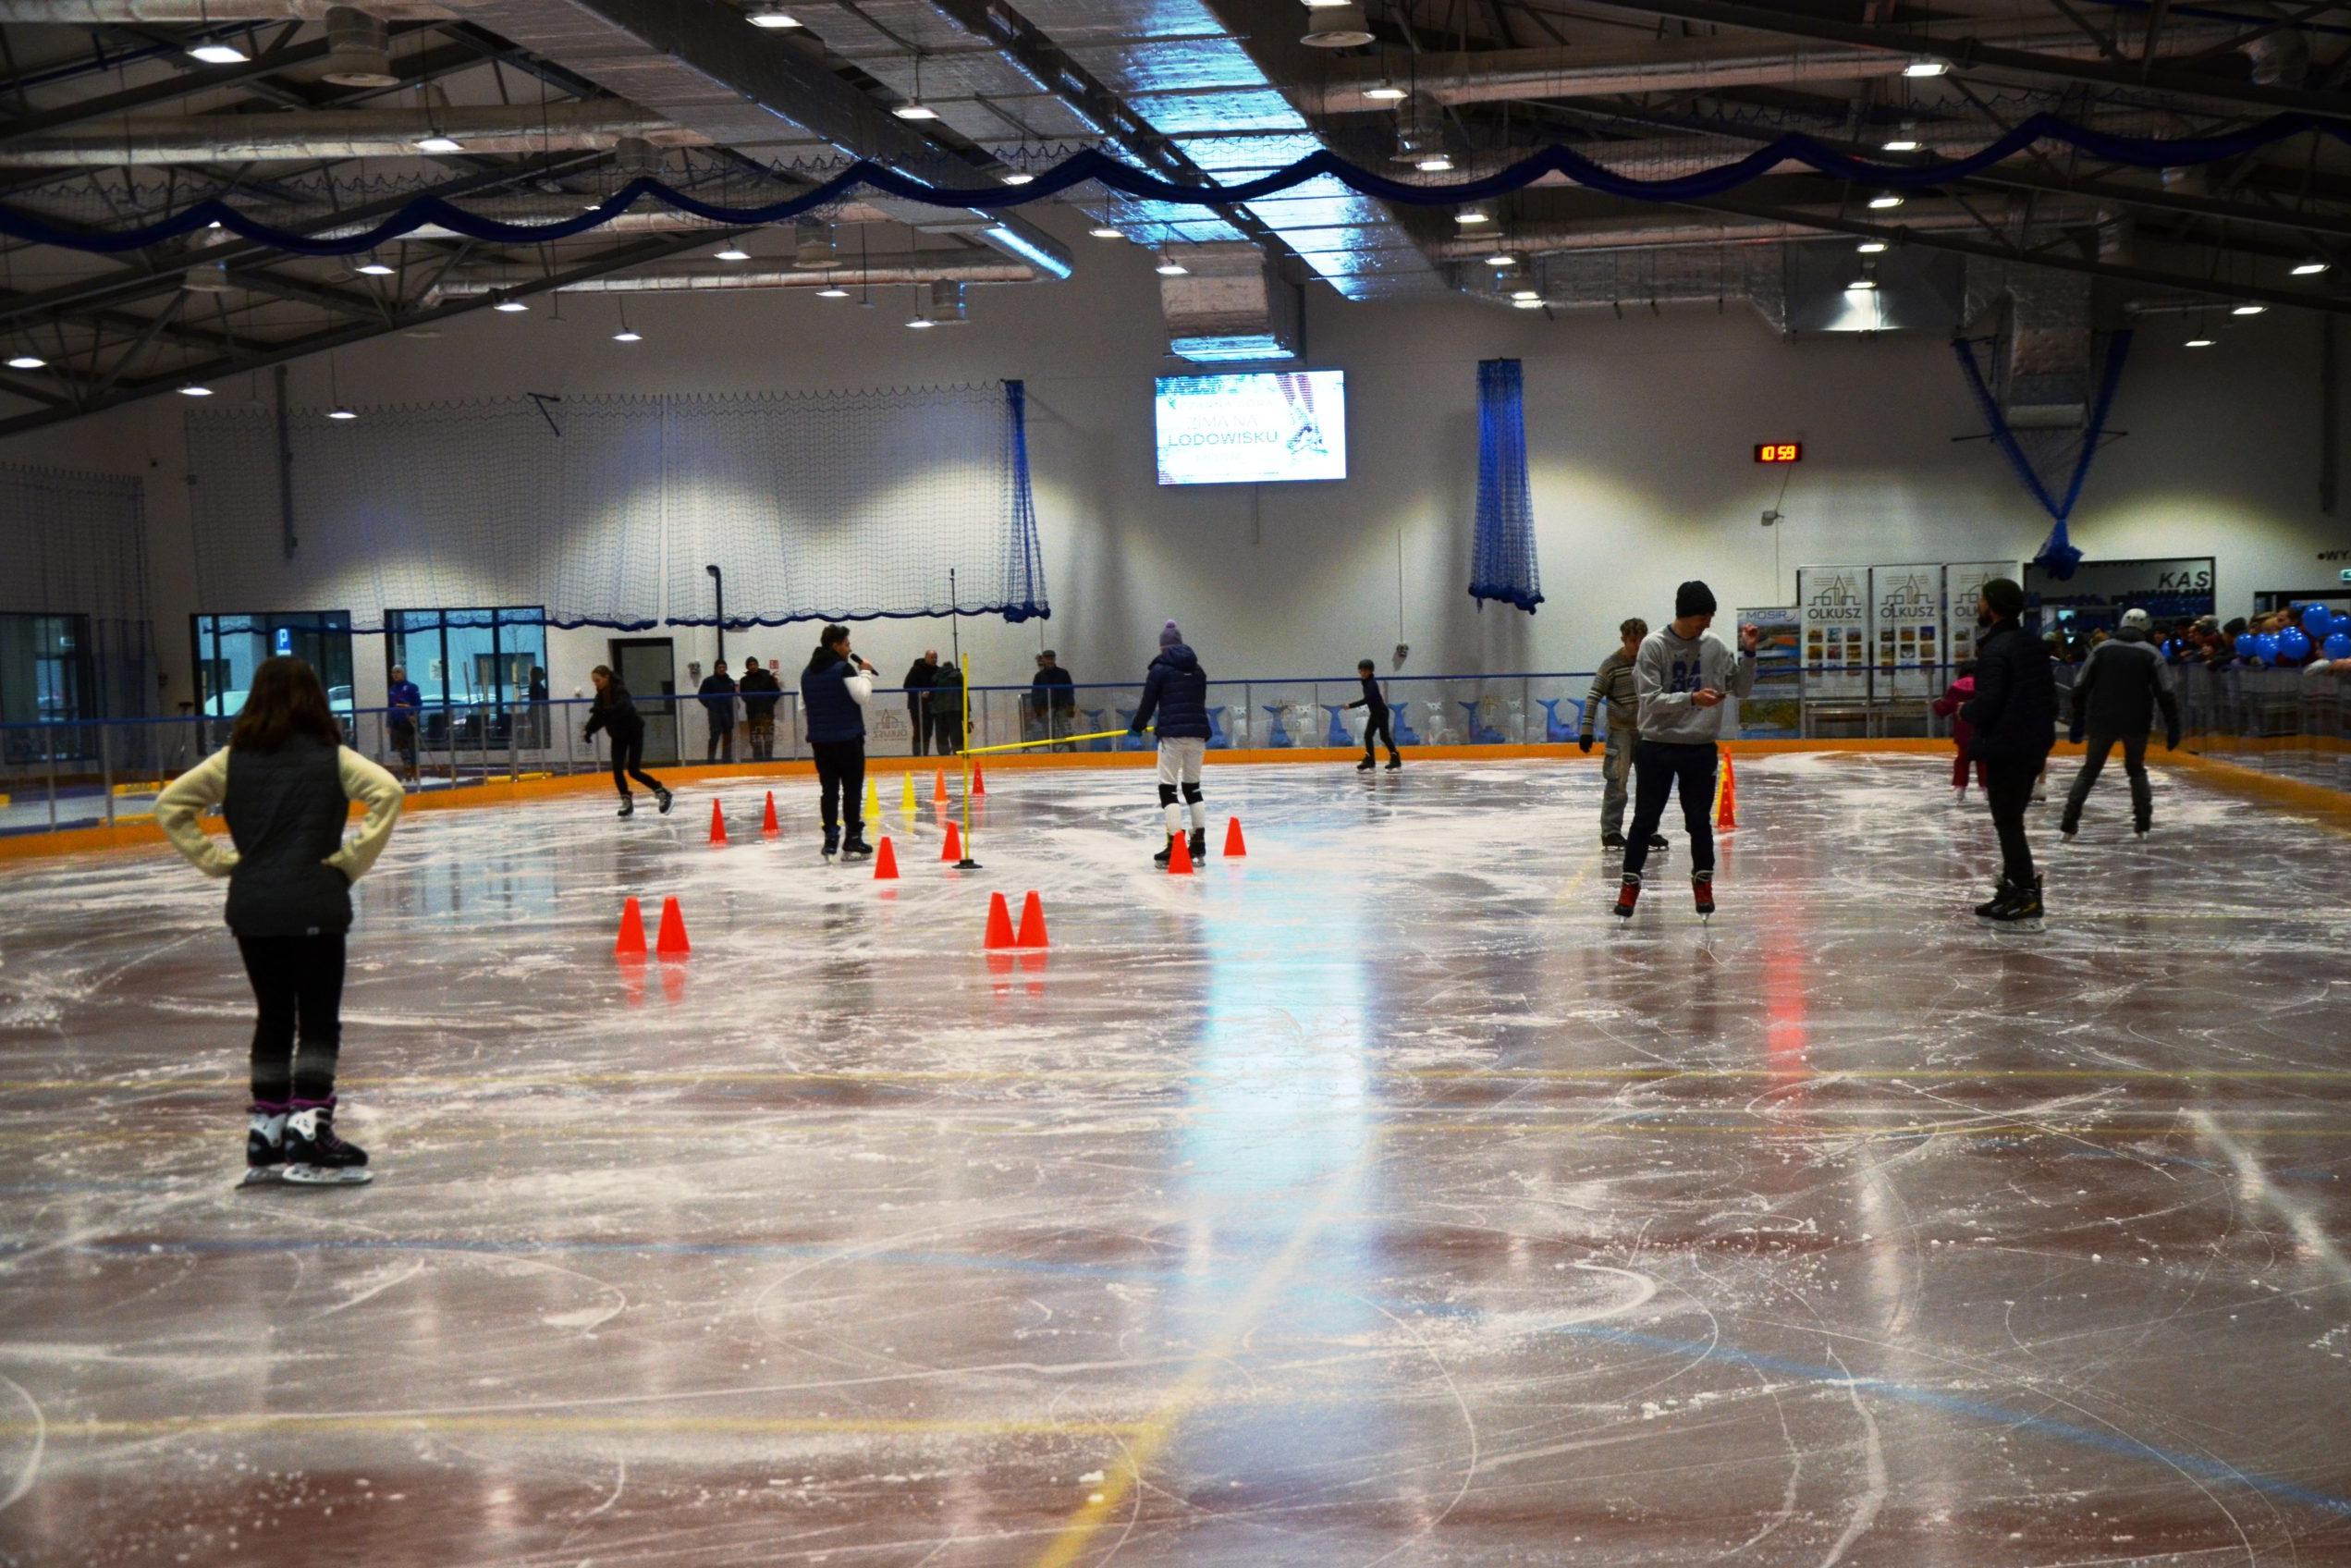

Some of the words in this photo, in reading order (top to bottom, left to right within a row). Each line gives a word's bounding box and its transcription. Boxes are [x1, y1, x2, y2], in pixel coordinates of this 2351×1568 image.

[1169, 431, 1278, 447] LODOWISKU
[1807, 607, 1862, 619] OLKUSZ
[1880, 606, 1935, 619] OLKUSZ
[279, 629, 288, 647] P
